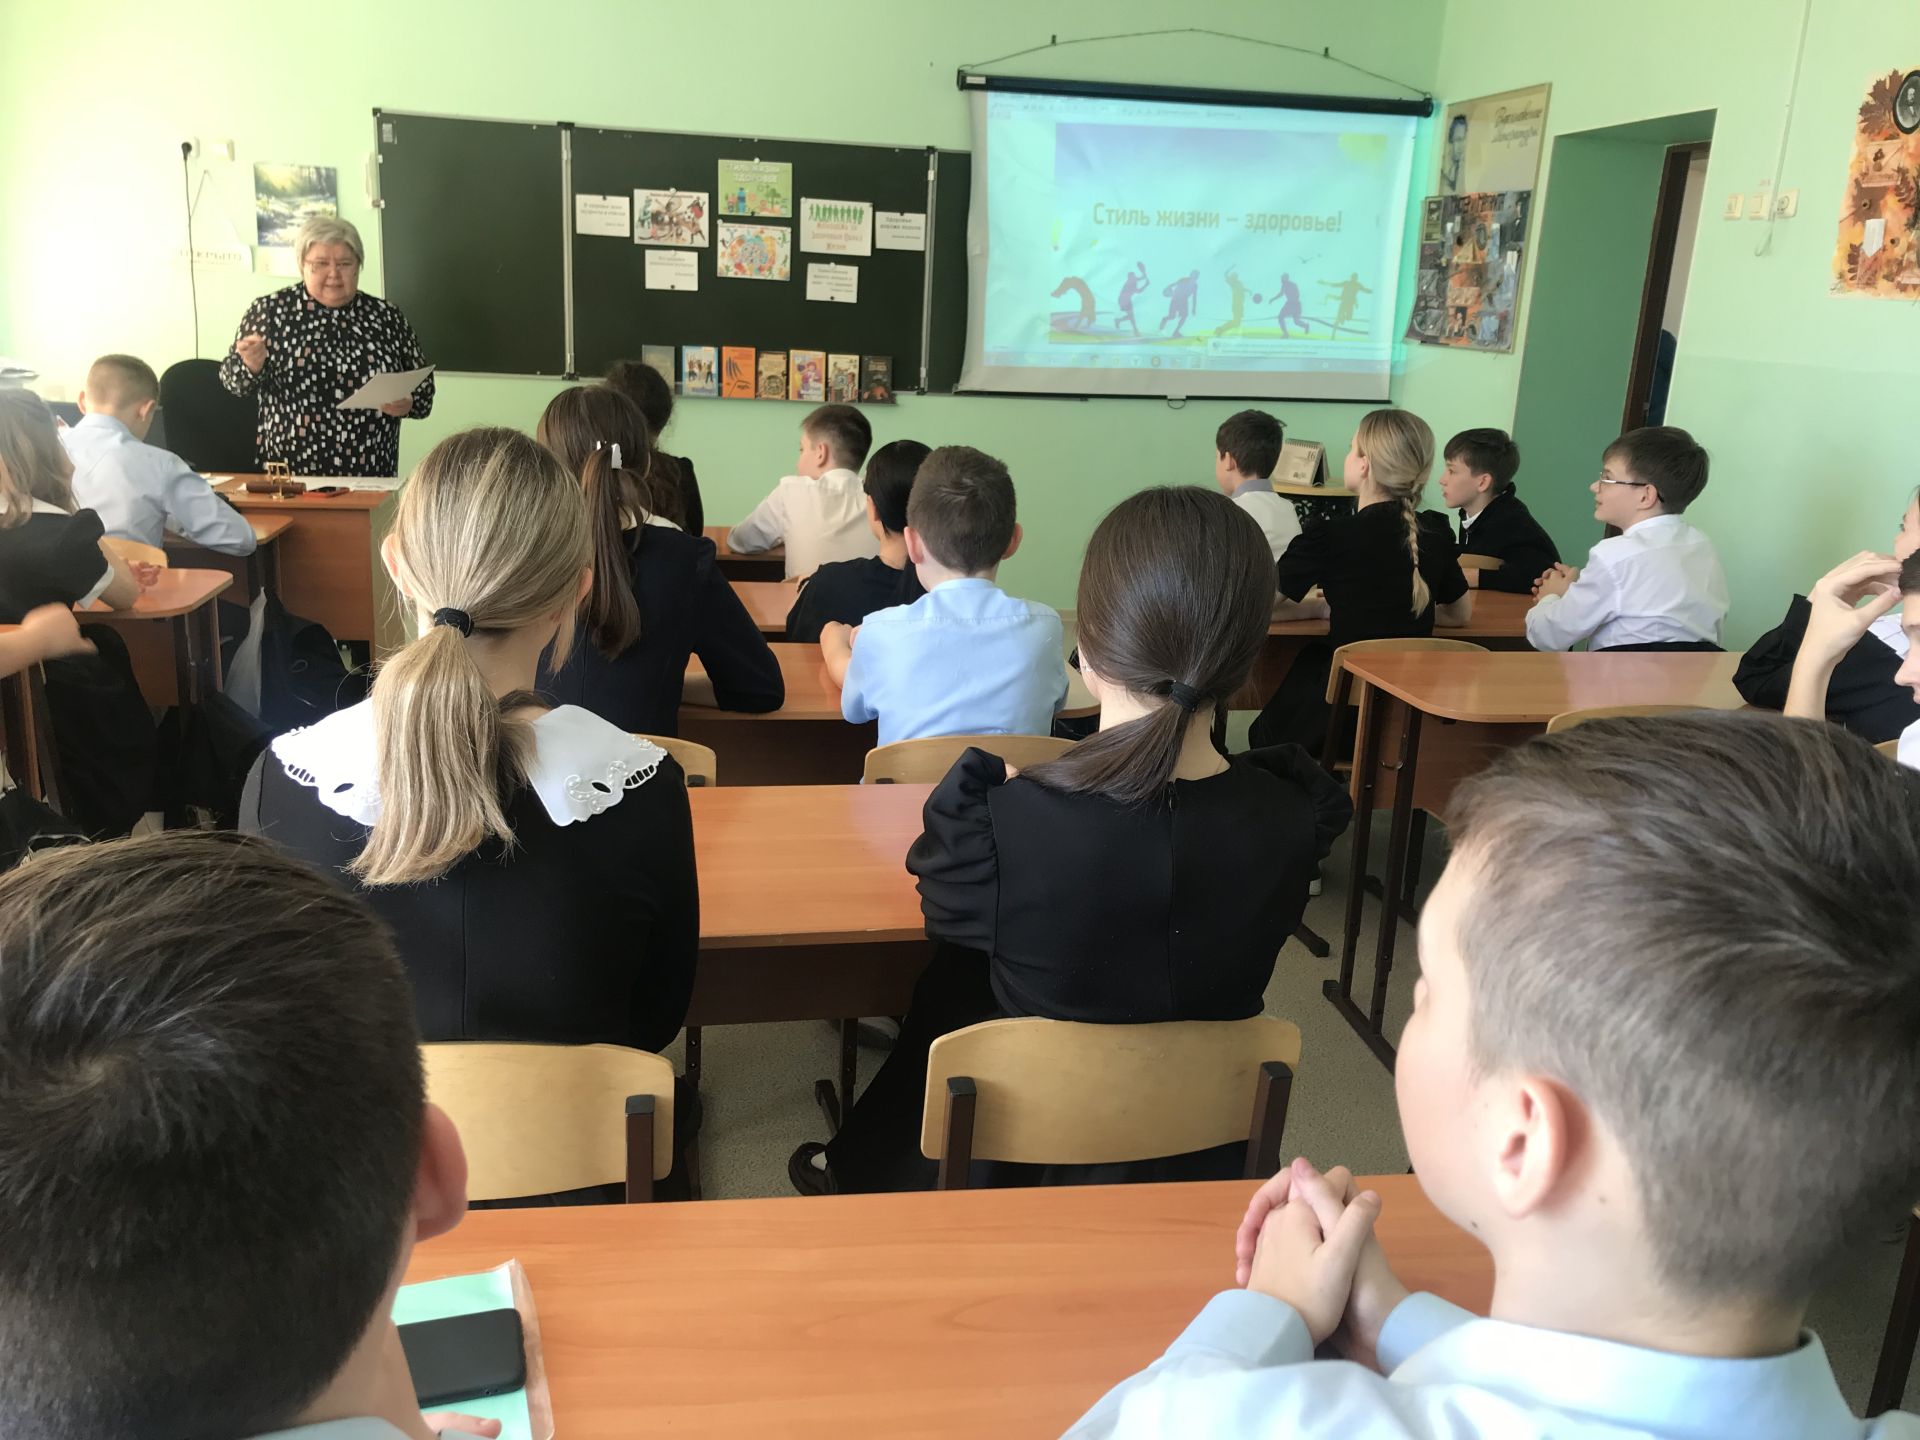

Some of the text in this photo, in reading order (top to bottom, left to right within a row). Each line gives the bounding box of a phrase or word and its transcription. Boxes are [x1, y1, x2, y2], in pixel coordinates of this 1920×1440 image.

[1093, 202, 1150, 226] Стиль
[1156, 209, 1220, 228] жизни
[1244, 210, 1343, 236] здоровье!
